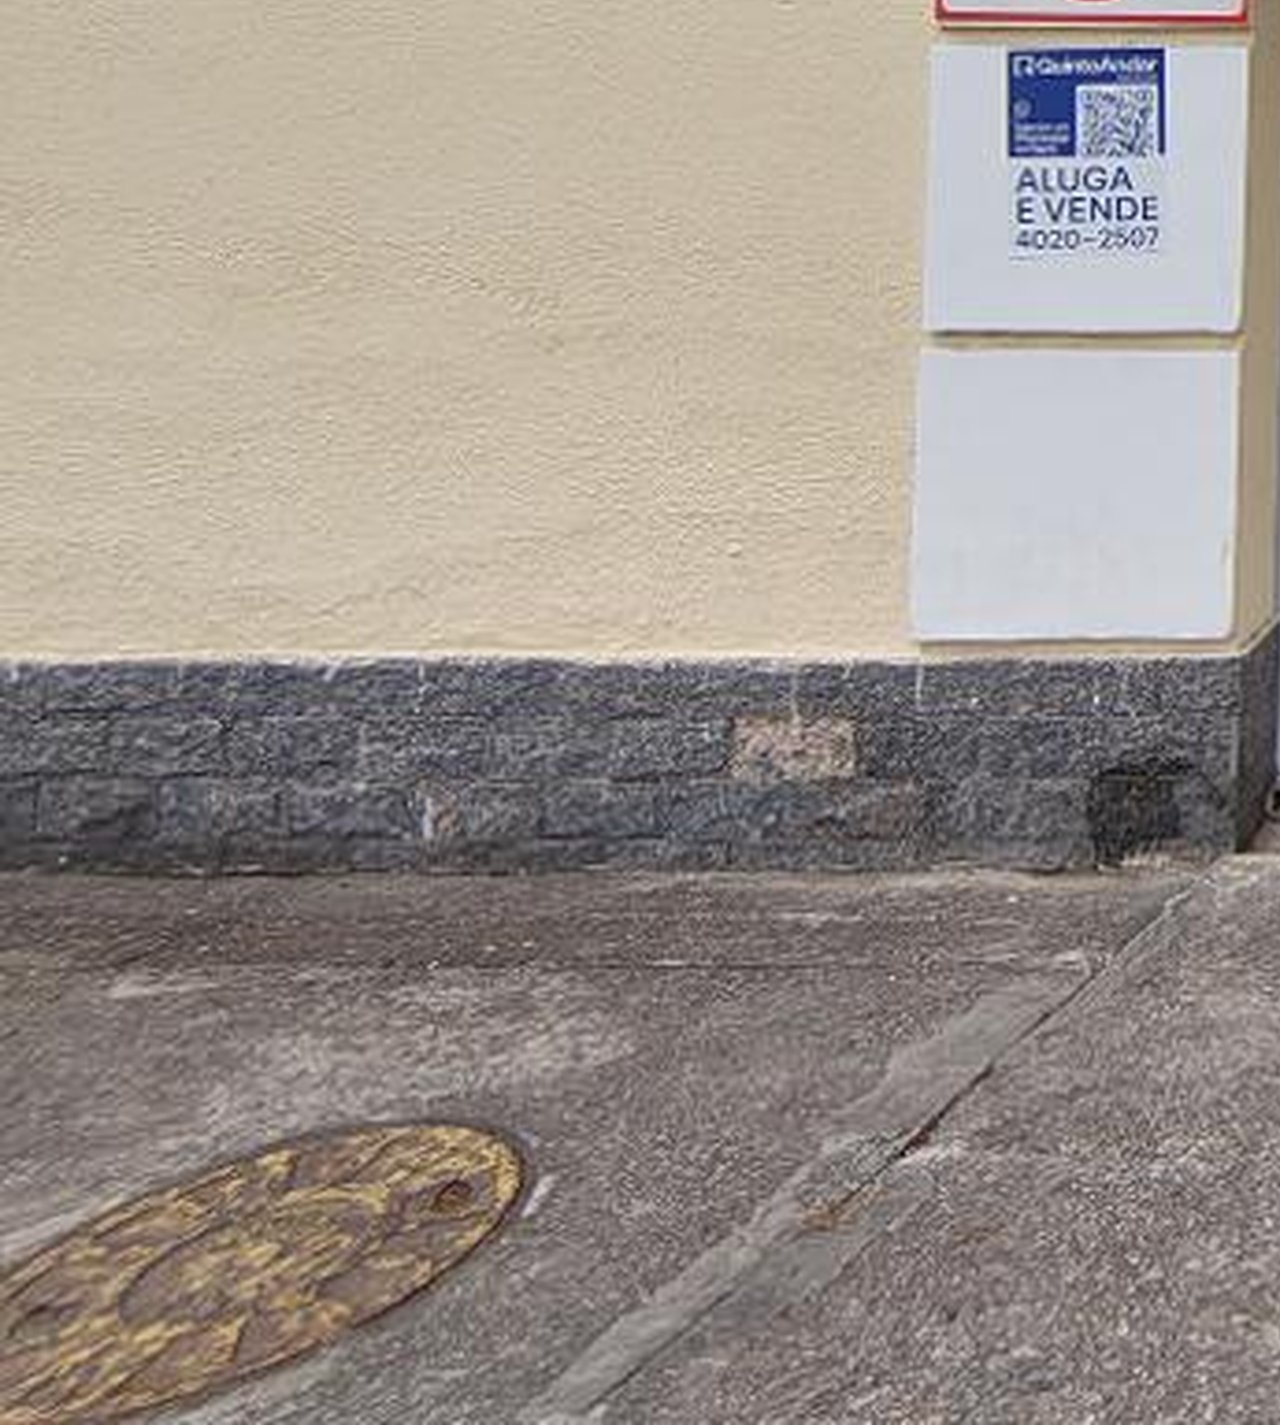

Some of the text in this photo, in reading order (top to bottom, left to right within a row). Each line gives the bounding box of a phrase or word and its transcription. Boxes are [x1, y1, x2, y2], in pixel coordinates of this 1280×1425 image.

[1016, 166, 1134, 193] ALUGA
[1016, 196, 1159, 224] E VENDE
[1016, 227, 1160, 250] 4020-2507
